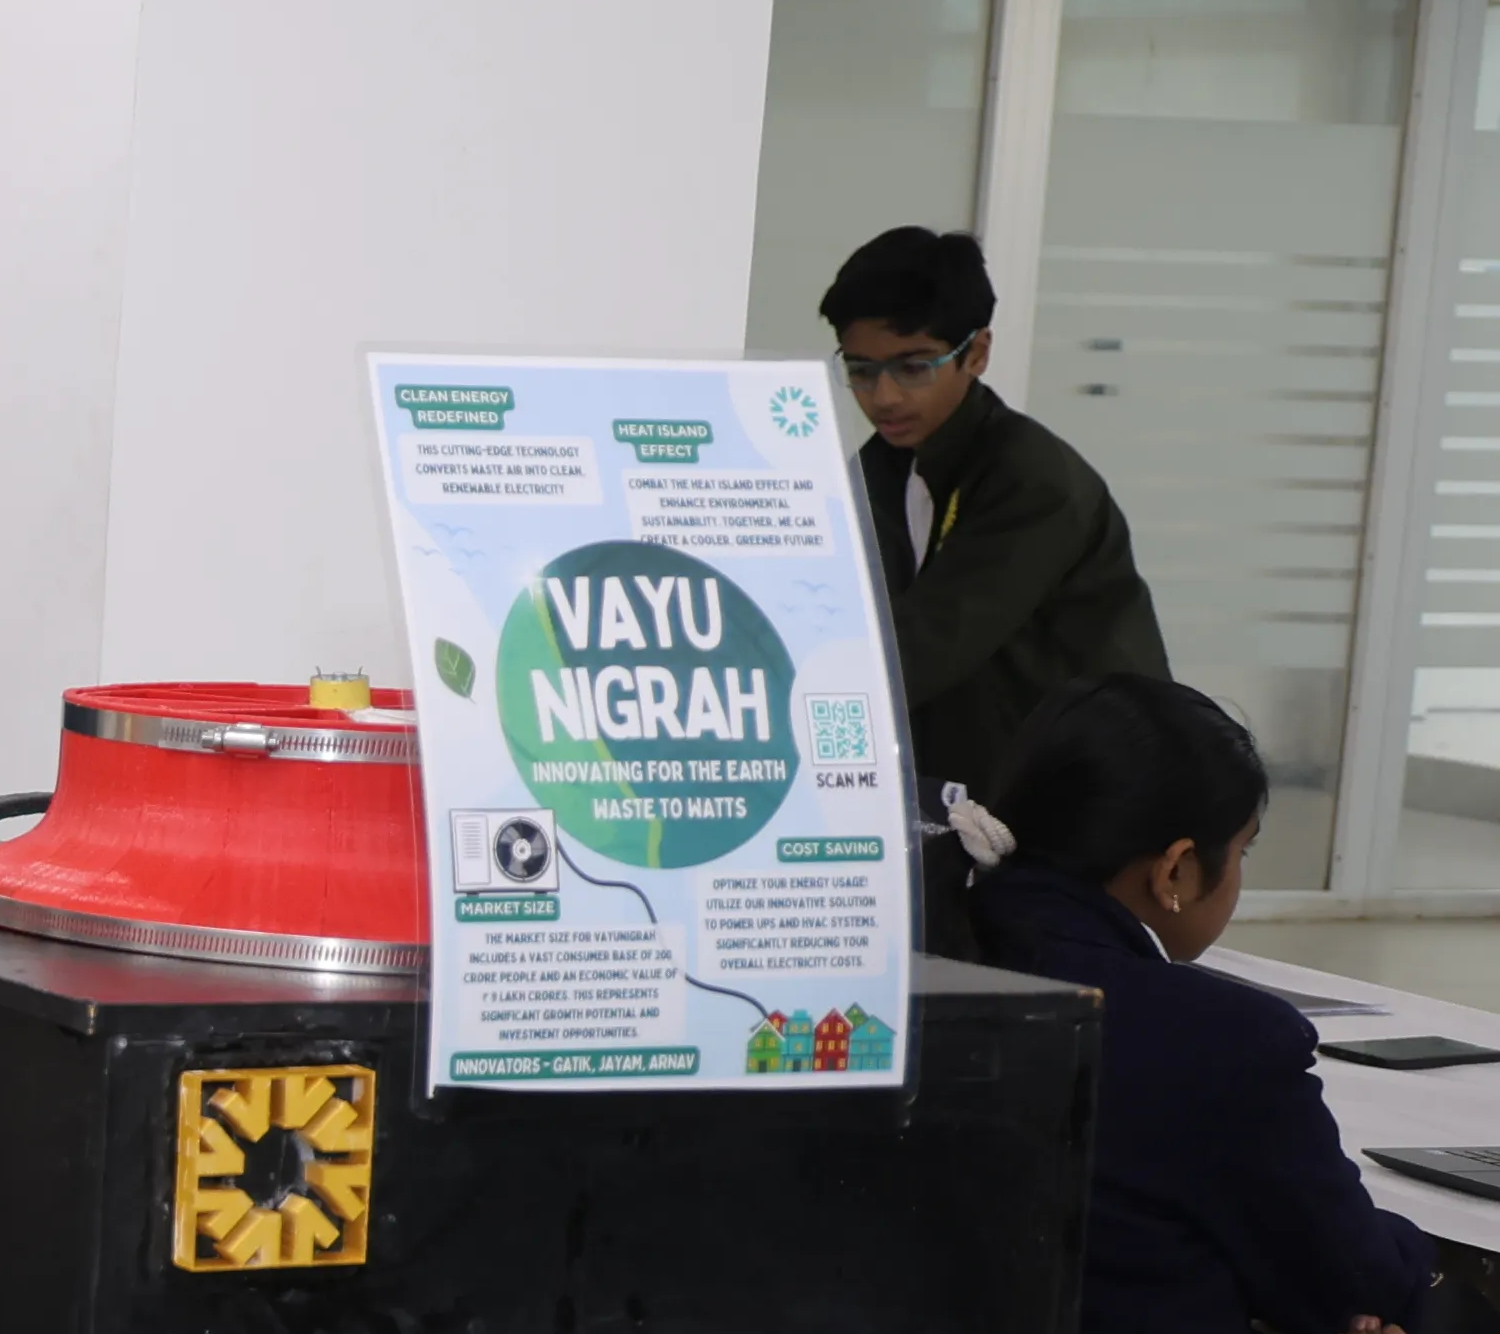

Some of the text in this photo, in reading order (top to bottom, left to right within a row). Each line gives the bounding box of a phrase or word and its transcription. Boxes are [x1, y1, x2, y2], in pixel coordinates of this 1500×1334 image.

[400, 390, 509, 405] CLEAN ENERGY
[546, 576, 724, 649] VAYU
[531, 666, 769, 744] NIGRAH
[532, 759, 786, 783] INNOVATING FOR THE EARTH
[815, 771, 878, 788] SCAN ME
[592, 796, 747, 820] WASTE TO WATTS
[781, 841, 879, 856] COST SAVING
[712, 877, 757, 890] OPTIMIZE
[760, 877, 787, 889] YOUR
[789, 876, 829, 889] ENERGY
[461, 901, 555, 915] MARKET SIZE
[705, 895, 876, 910] UTILIZE OUR INNOVATIVE SOLUTION
[704, 918, 717, 930] TO
[718, 917, 754, 930] POWER
[756, 917, 776, 929] UPS
[778, 917, 800, 930] AND
[801, 916, 827, 930] HVAC
[456, 1057, 541, 1075] INNOVATORS
[552, 1055, 596, 1074] GATIK,
[598, 1055, 646, 1073] JAYAM,
[648, 1053, 695, 1071] ARNAV
